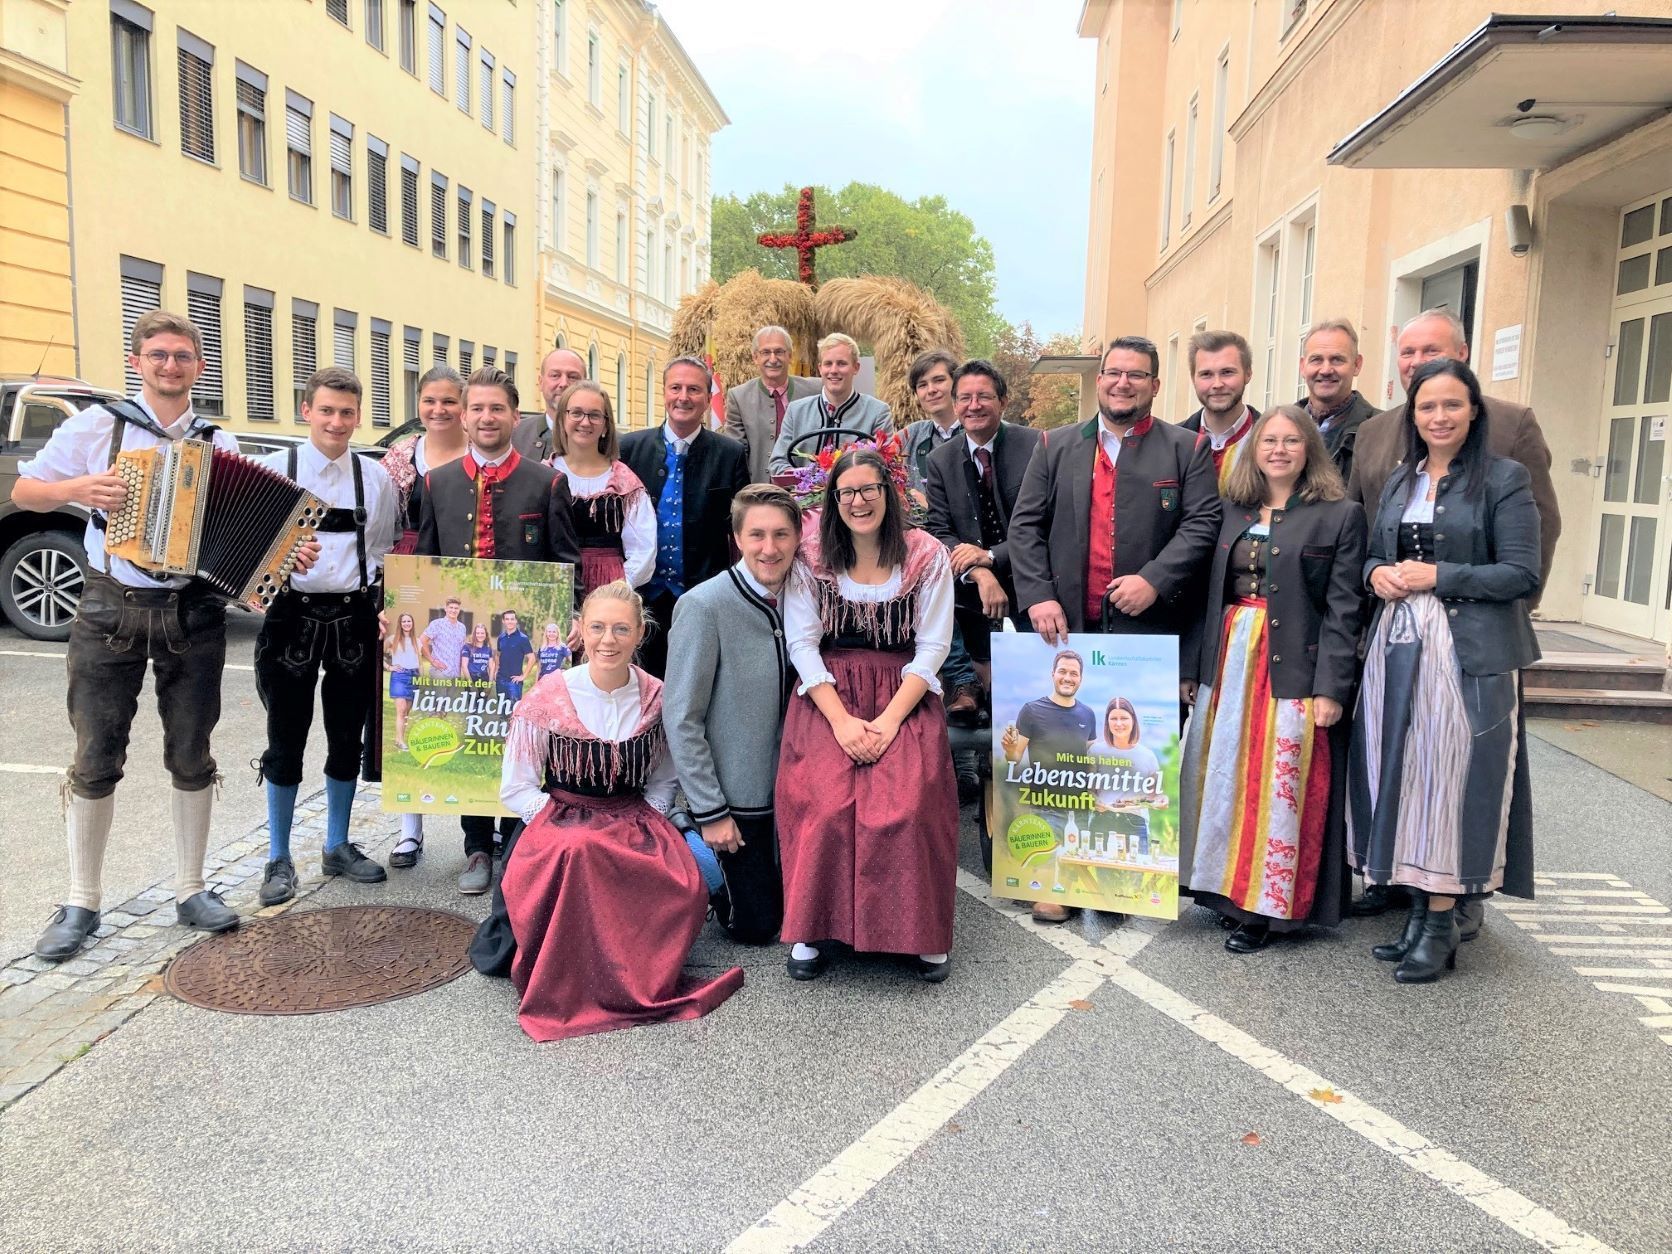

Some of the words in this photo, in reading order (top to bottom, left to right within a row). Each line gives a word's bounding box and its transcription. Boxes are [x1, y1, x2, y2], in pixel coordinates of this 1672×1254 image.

[1092, 650, 1106, 666] lk
[412, 676, 430, 686] Mit
[433, 678, 452, 687] uns
[455, 678, 472, 688] hat
[475, 678, 493, 689] der
[412, 689, 515, 715] ländlich
[464, 715, 510, 737] Rau
[410, 733, 454, 747] BÄUERINNEN
[422, 740, 451, 751] BAUERN
[464, 738, 506, 756] Zuk
[1056, 752, 1074, 763] Mit
[1077, 755, 1096, 765] uns
[1098, 755, 1132, 767] haben
[1005, 760, 1164, 795] Lebensmittel
[1019, 787, 1096, 811] Zukunft
[1010, 832, 1051, 843] BÄUERINNEN
[1021, 840, 1048, 849] BAUERN
